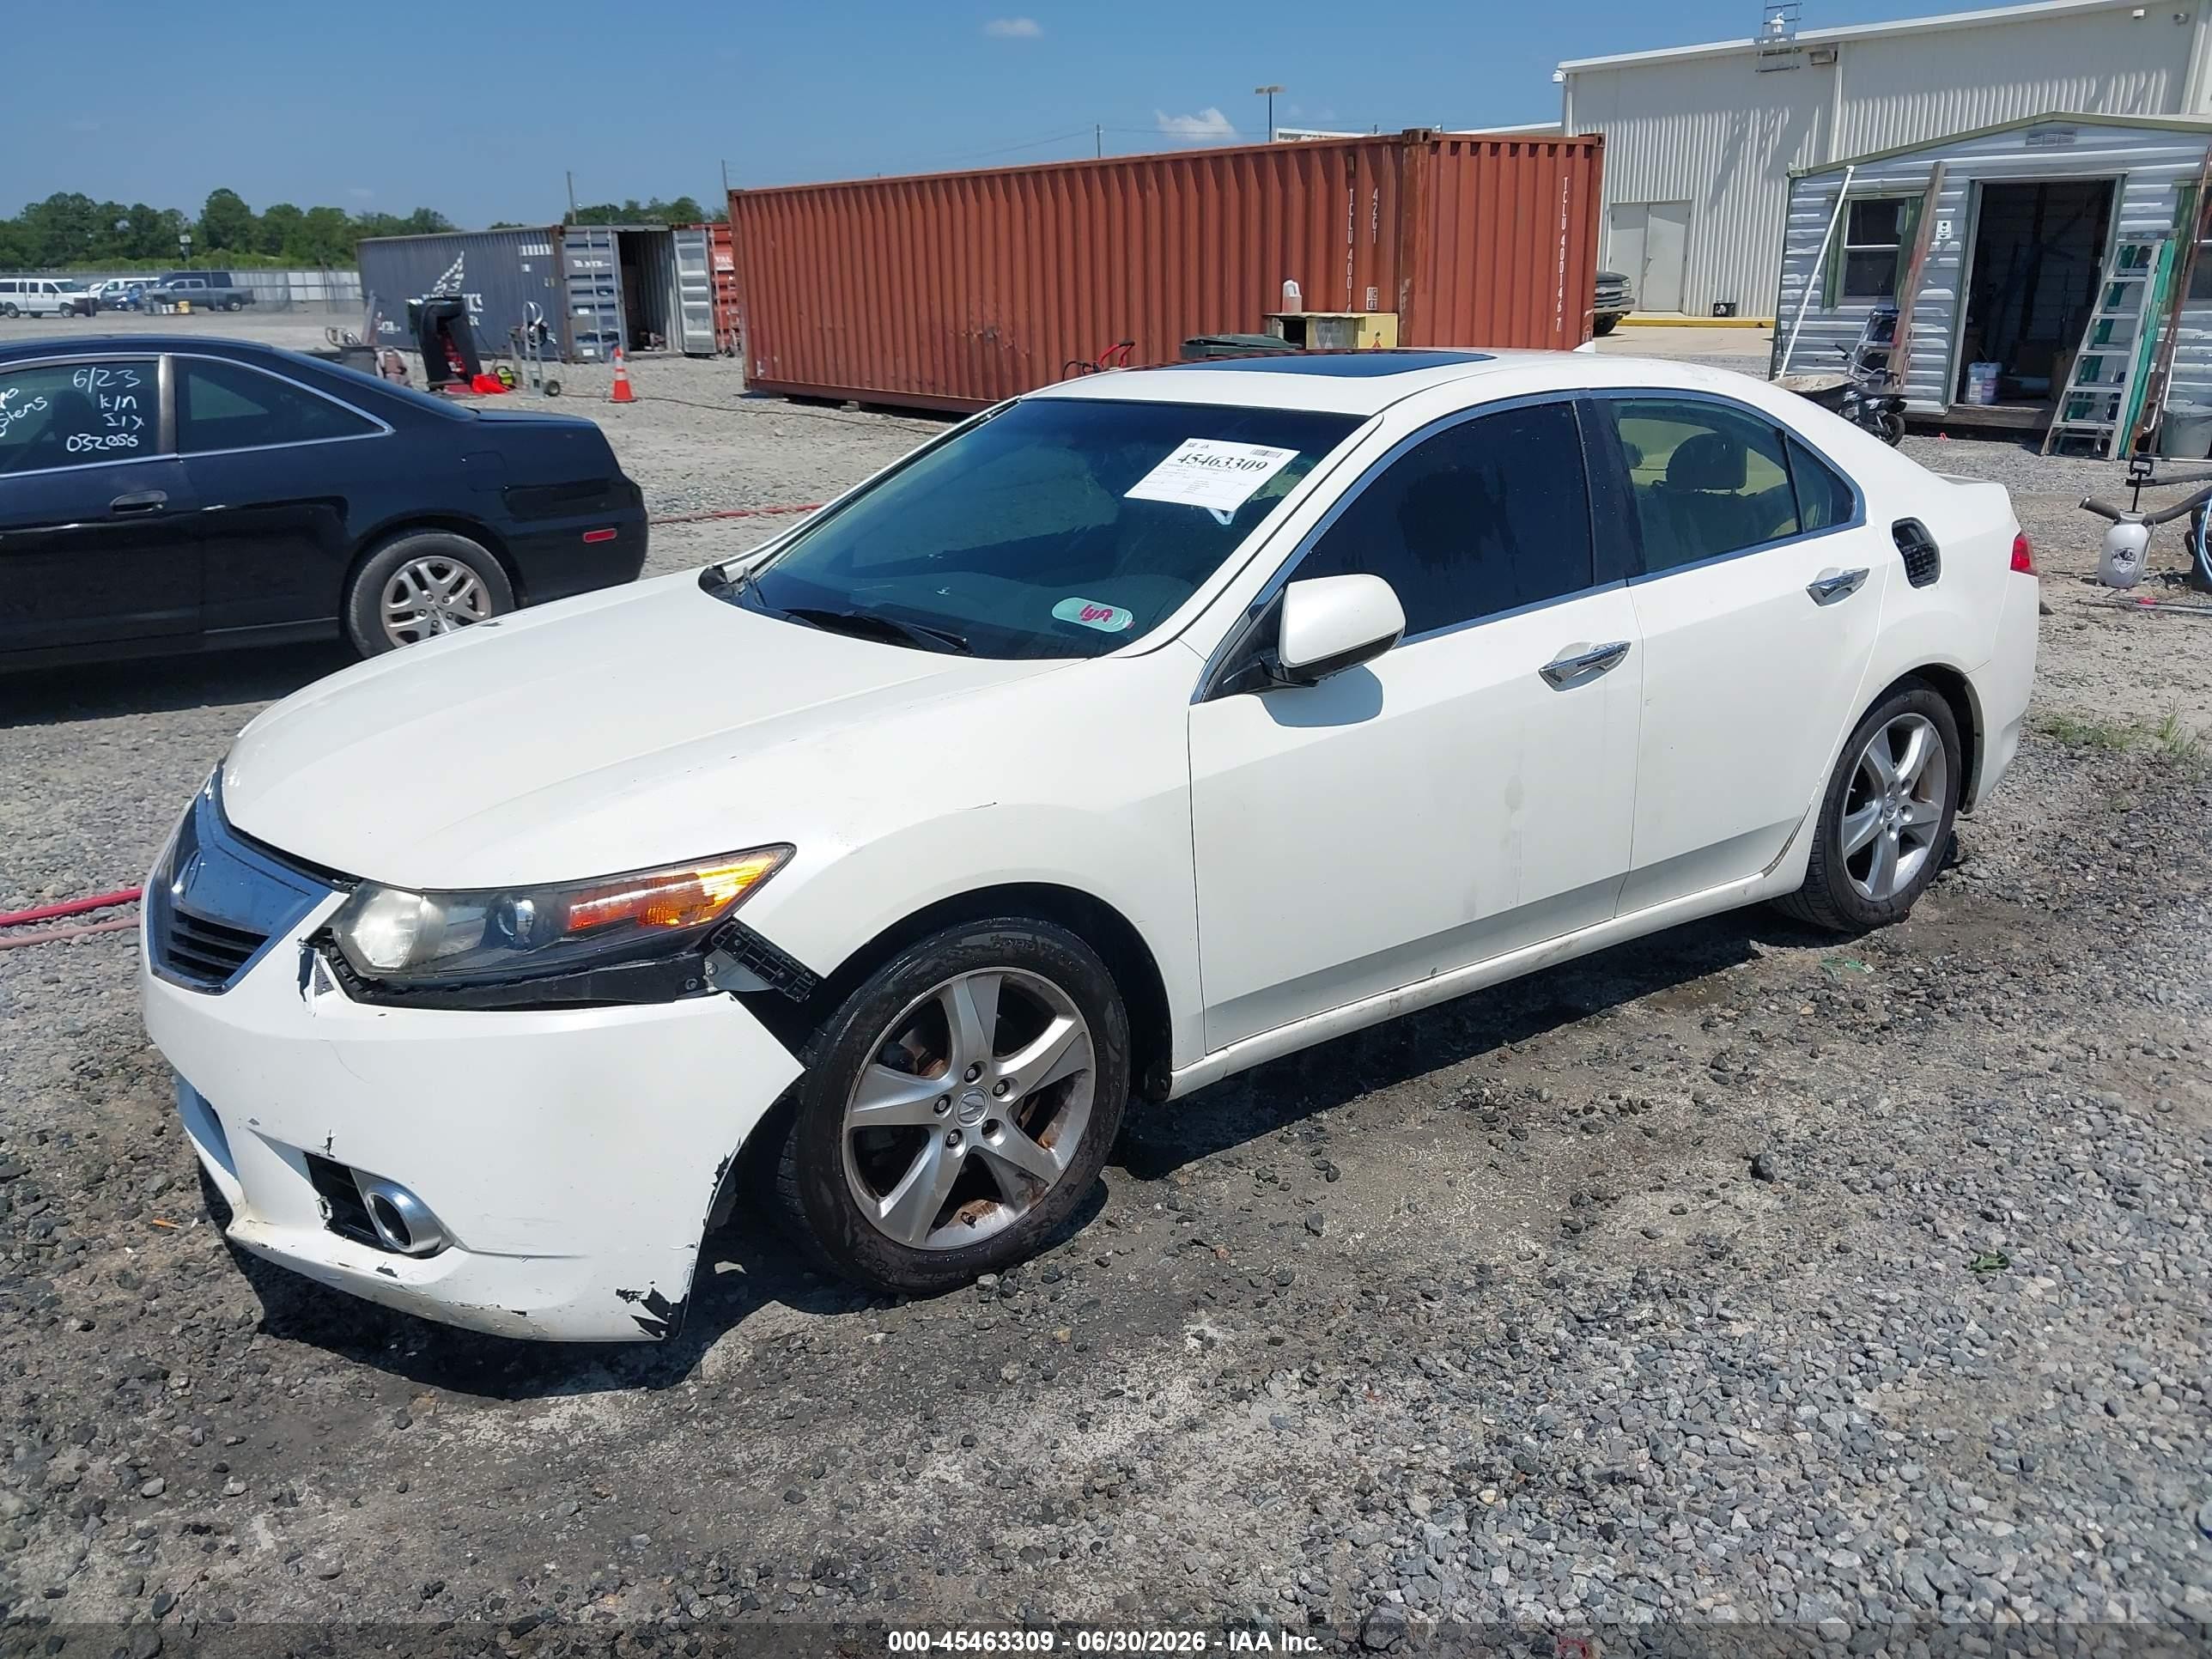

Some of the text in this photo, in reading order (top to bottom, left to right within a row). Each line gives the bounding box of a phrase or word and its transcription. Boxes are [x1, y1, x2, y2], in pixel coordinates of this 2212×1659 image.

[1557, 234, 1565, 313] 400146
[73, 367, 141, 393] 6/23
[1177, 453, 1268, 472] 45463309
